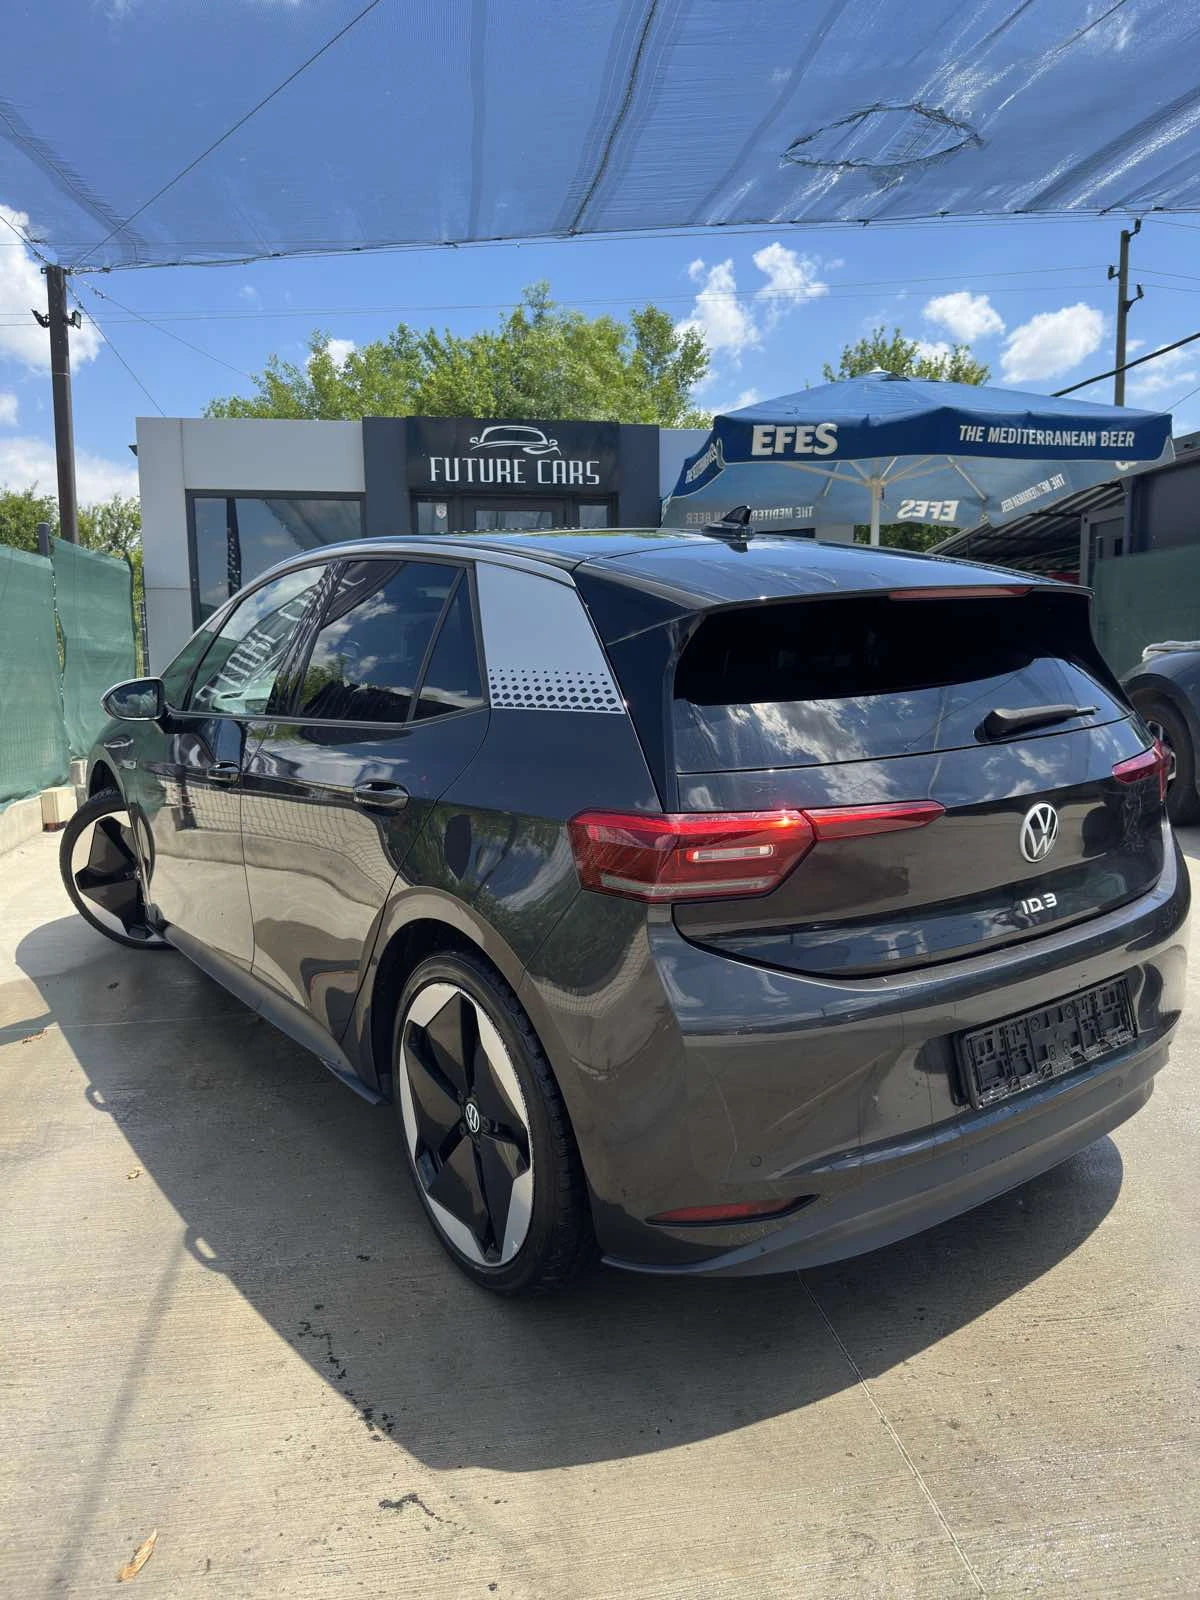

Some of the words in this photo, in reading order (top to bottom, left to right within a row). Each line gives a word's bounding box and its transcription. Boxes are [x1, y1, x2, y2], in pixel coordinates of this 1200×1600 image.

[751, 423, 839, 456] EFES
[959, 425, 985, 442] THE
[987, 427, 1097, 446] MEDITERRANEAN
[1100, 431, 1136, 448] BEER
[430, 457, 526, 484] FUTURE
[537, 459, 600, 485] CARS
[1021, 802, 1058, 862] VW
[1021, 893, 1057, 914] ID.3
